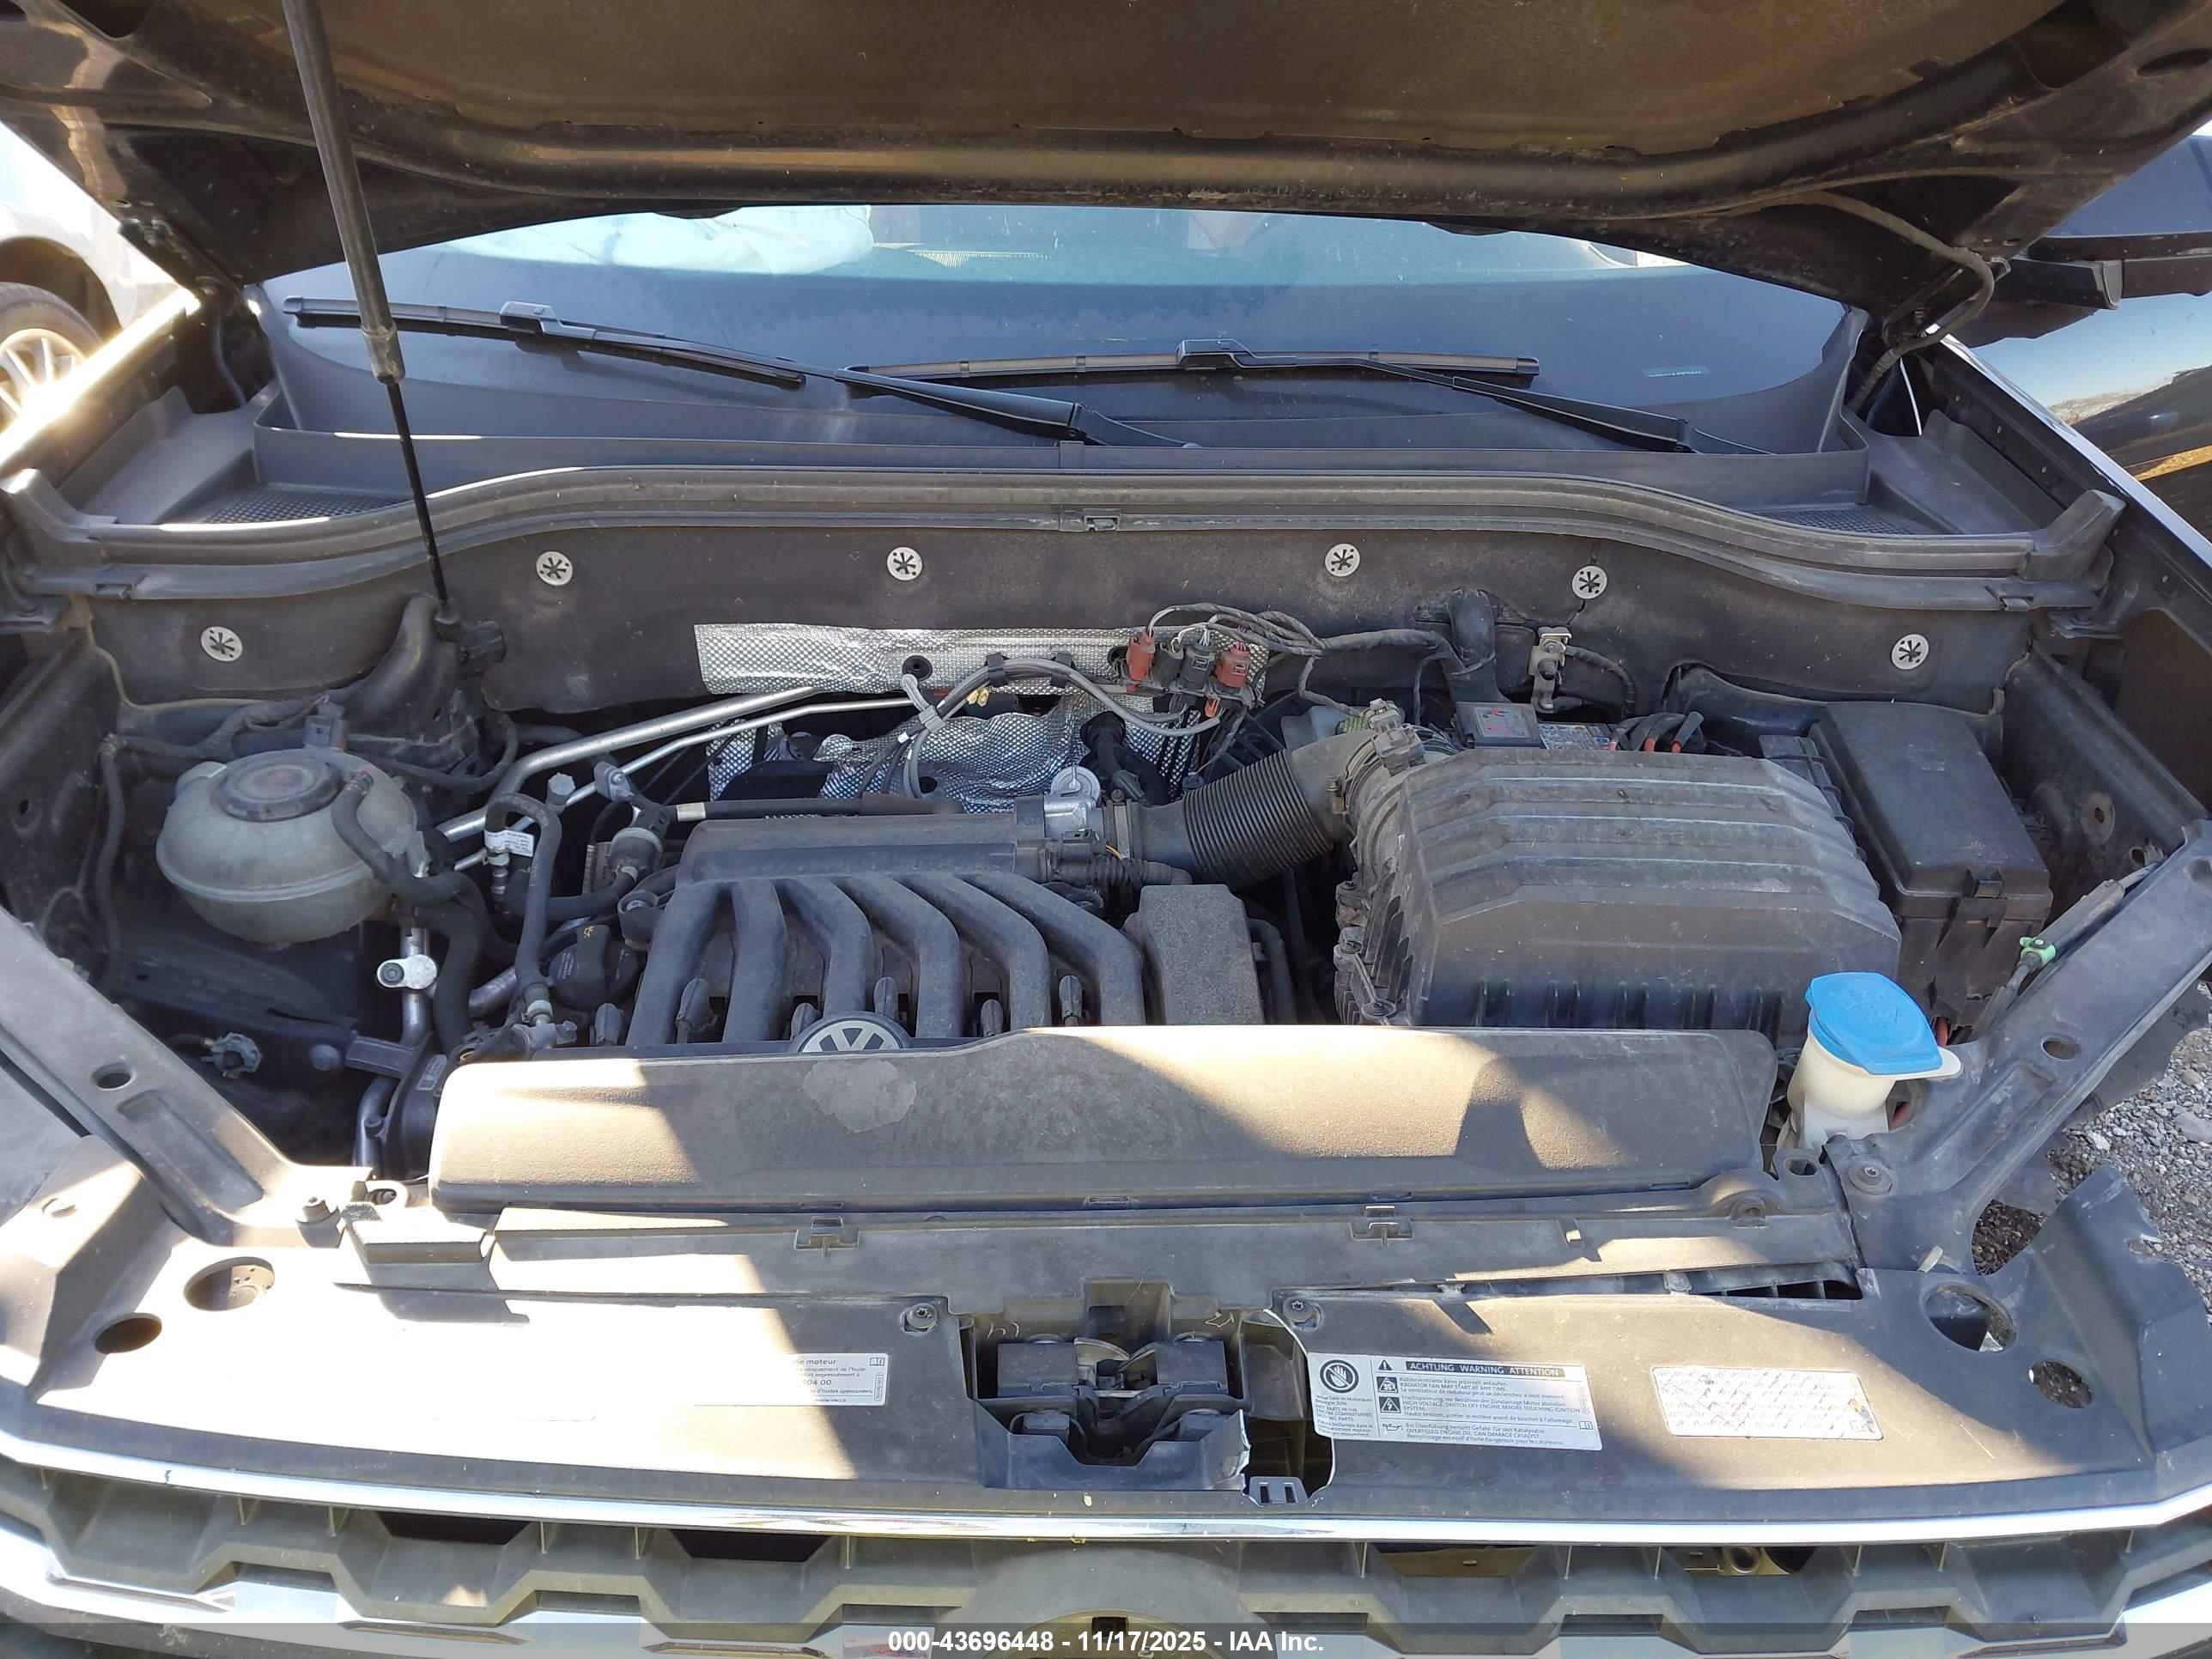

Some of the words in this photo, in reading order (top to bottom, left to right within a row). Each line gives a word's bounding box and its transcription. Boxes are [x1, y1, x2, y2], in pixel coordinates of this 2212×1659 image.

[1410, 1362, 1455, 1371] ACHTUNG
[1460, 1364, 1504, 1374] WARNING
[1510, 1366, 1559, 1376] ATTENTION
